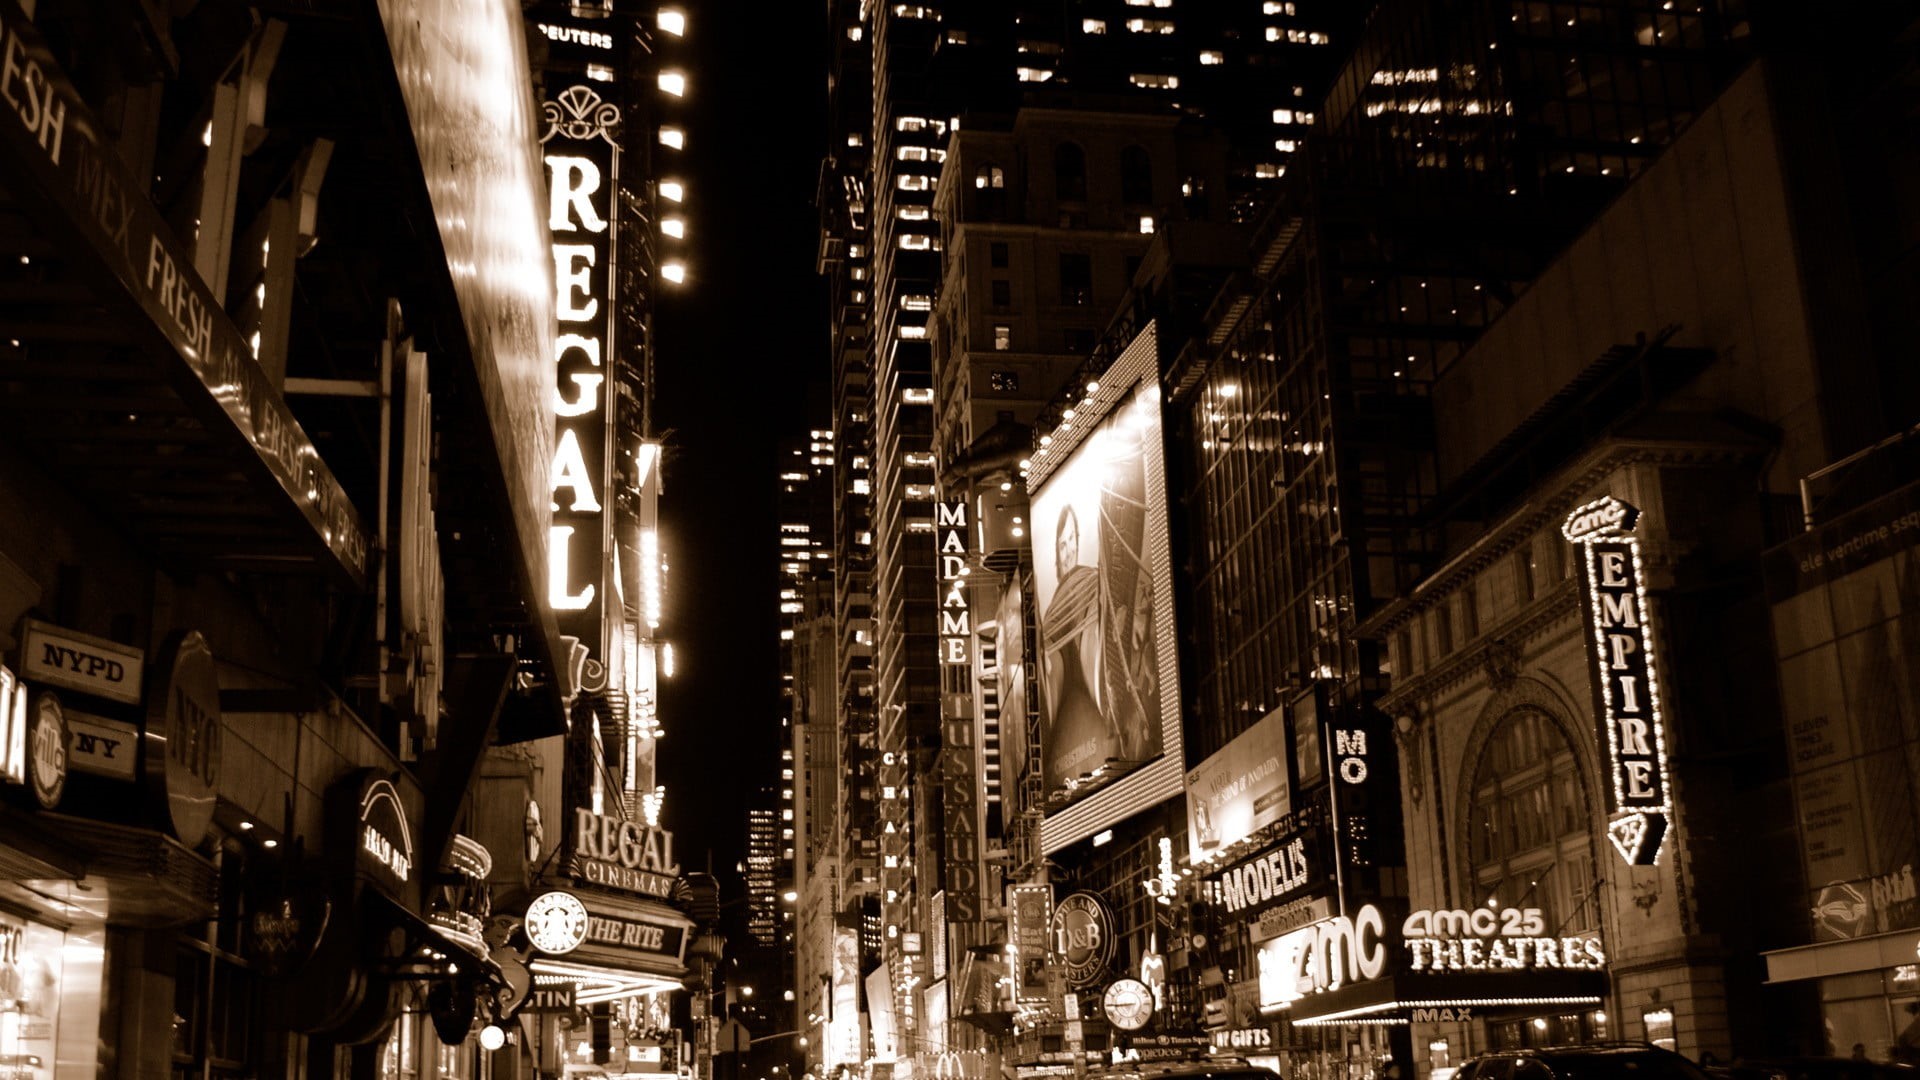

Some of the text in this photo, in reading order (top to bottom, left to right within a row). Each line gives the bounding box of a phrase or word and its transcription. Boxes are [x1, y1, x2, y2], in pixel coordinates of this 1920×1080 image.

[538, 23, 613, 49] EUTERS
[0, 17, 66, 167] ESH
[147, 232, 212, 364] FRESH
[262, 400, 302, 490] FRESH
[544, 155, 608, 610] REGAL
[938, 502, 970, 664] MADAME
[42, 643, 124, 683] NYPD
[1599, 551, 1655, 798] EMPIRE
[31, 717, 66, 777] villa
[77, 732, 120, 759] NY
[171, 685, 217, 788] NYC
[947, 696, 975, 922] TUSSAUDS
[575, 807, 680, 876] REGAL
[882, 752, 898, 938] CHAMPS
[1620, 822, 1640, 848] 25
[585, 861, 671, 898] CINEMAS
[1079, 899, 1099, 918] AND
[586, 915, 622, 945] THE
[622, 922, 664, 950] RITE
[1056, 923, 1101, 955] D&B
[1404, 936, 1606, 971] THEATRES
[526, 990, 571, 1009] TIN
[1412, 1007, 1473, 1023] IMAX
[1231, 1028, 1270, 1048] GIFTS
